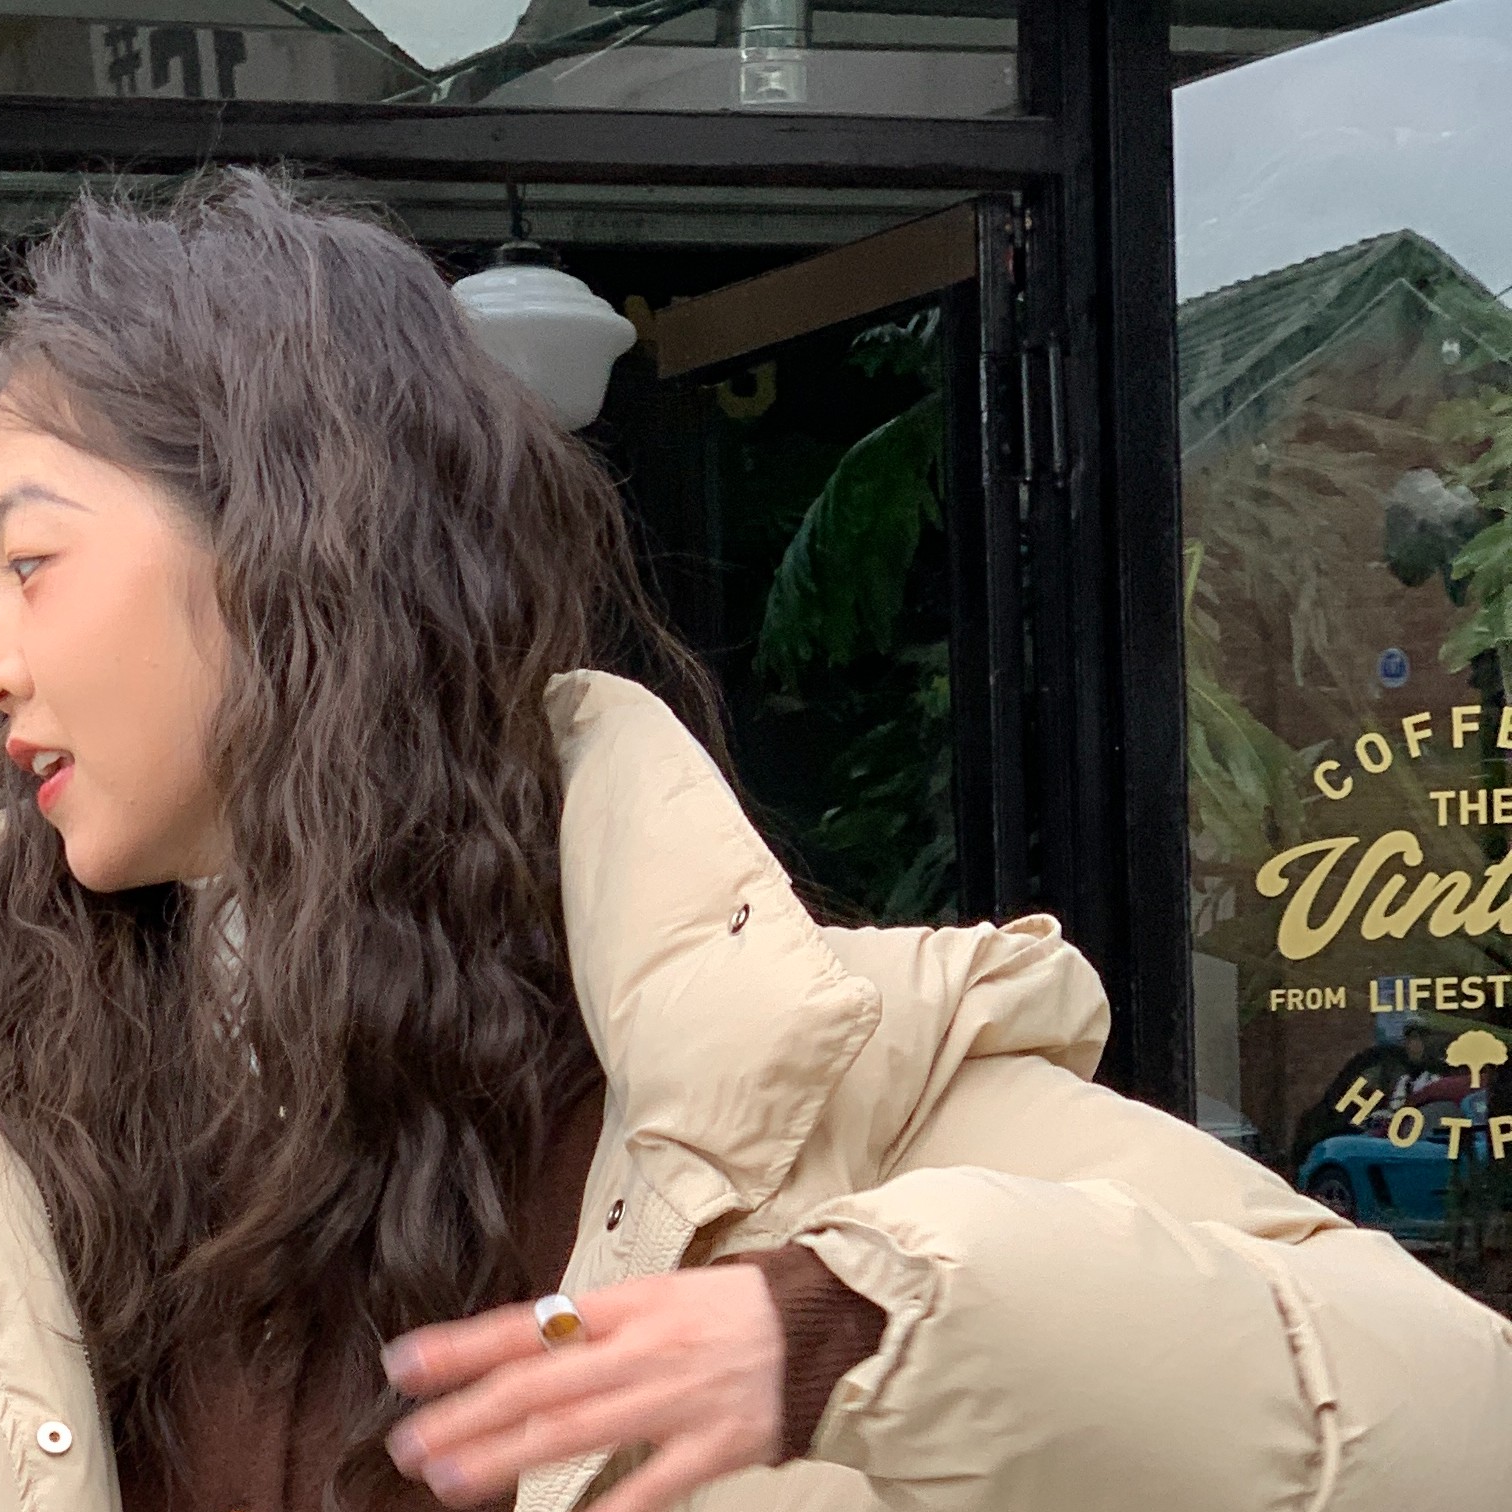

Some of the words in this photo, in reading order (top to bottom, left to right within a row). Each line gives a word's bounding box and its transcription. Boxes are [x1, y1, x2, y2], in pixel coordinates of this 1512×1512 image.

[1430, 788, 1512, 827] THE
[1269, 984, 1347, 1013] FROM
[1368, 973, 1512, 1014] LIFEST
[1334, 1075, 1512, 1161] HOTP
